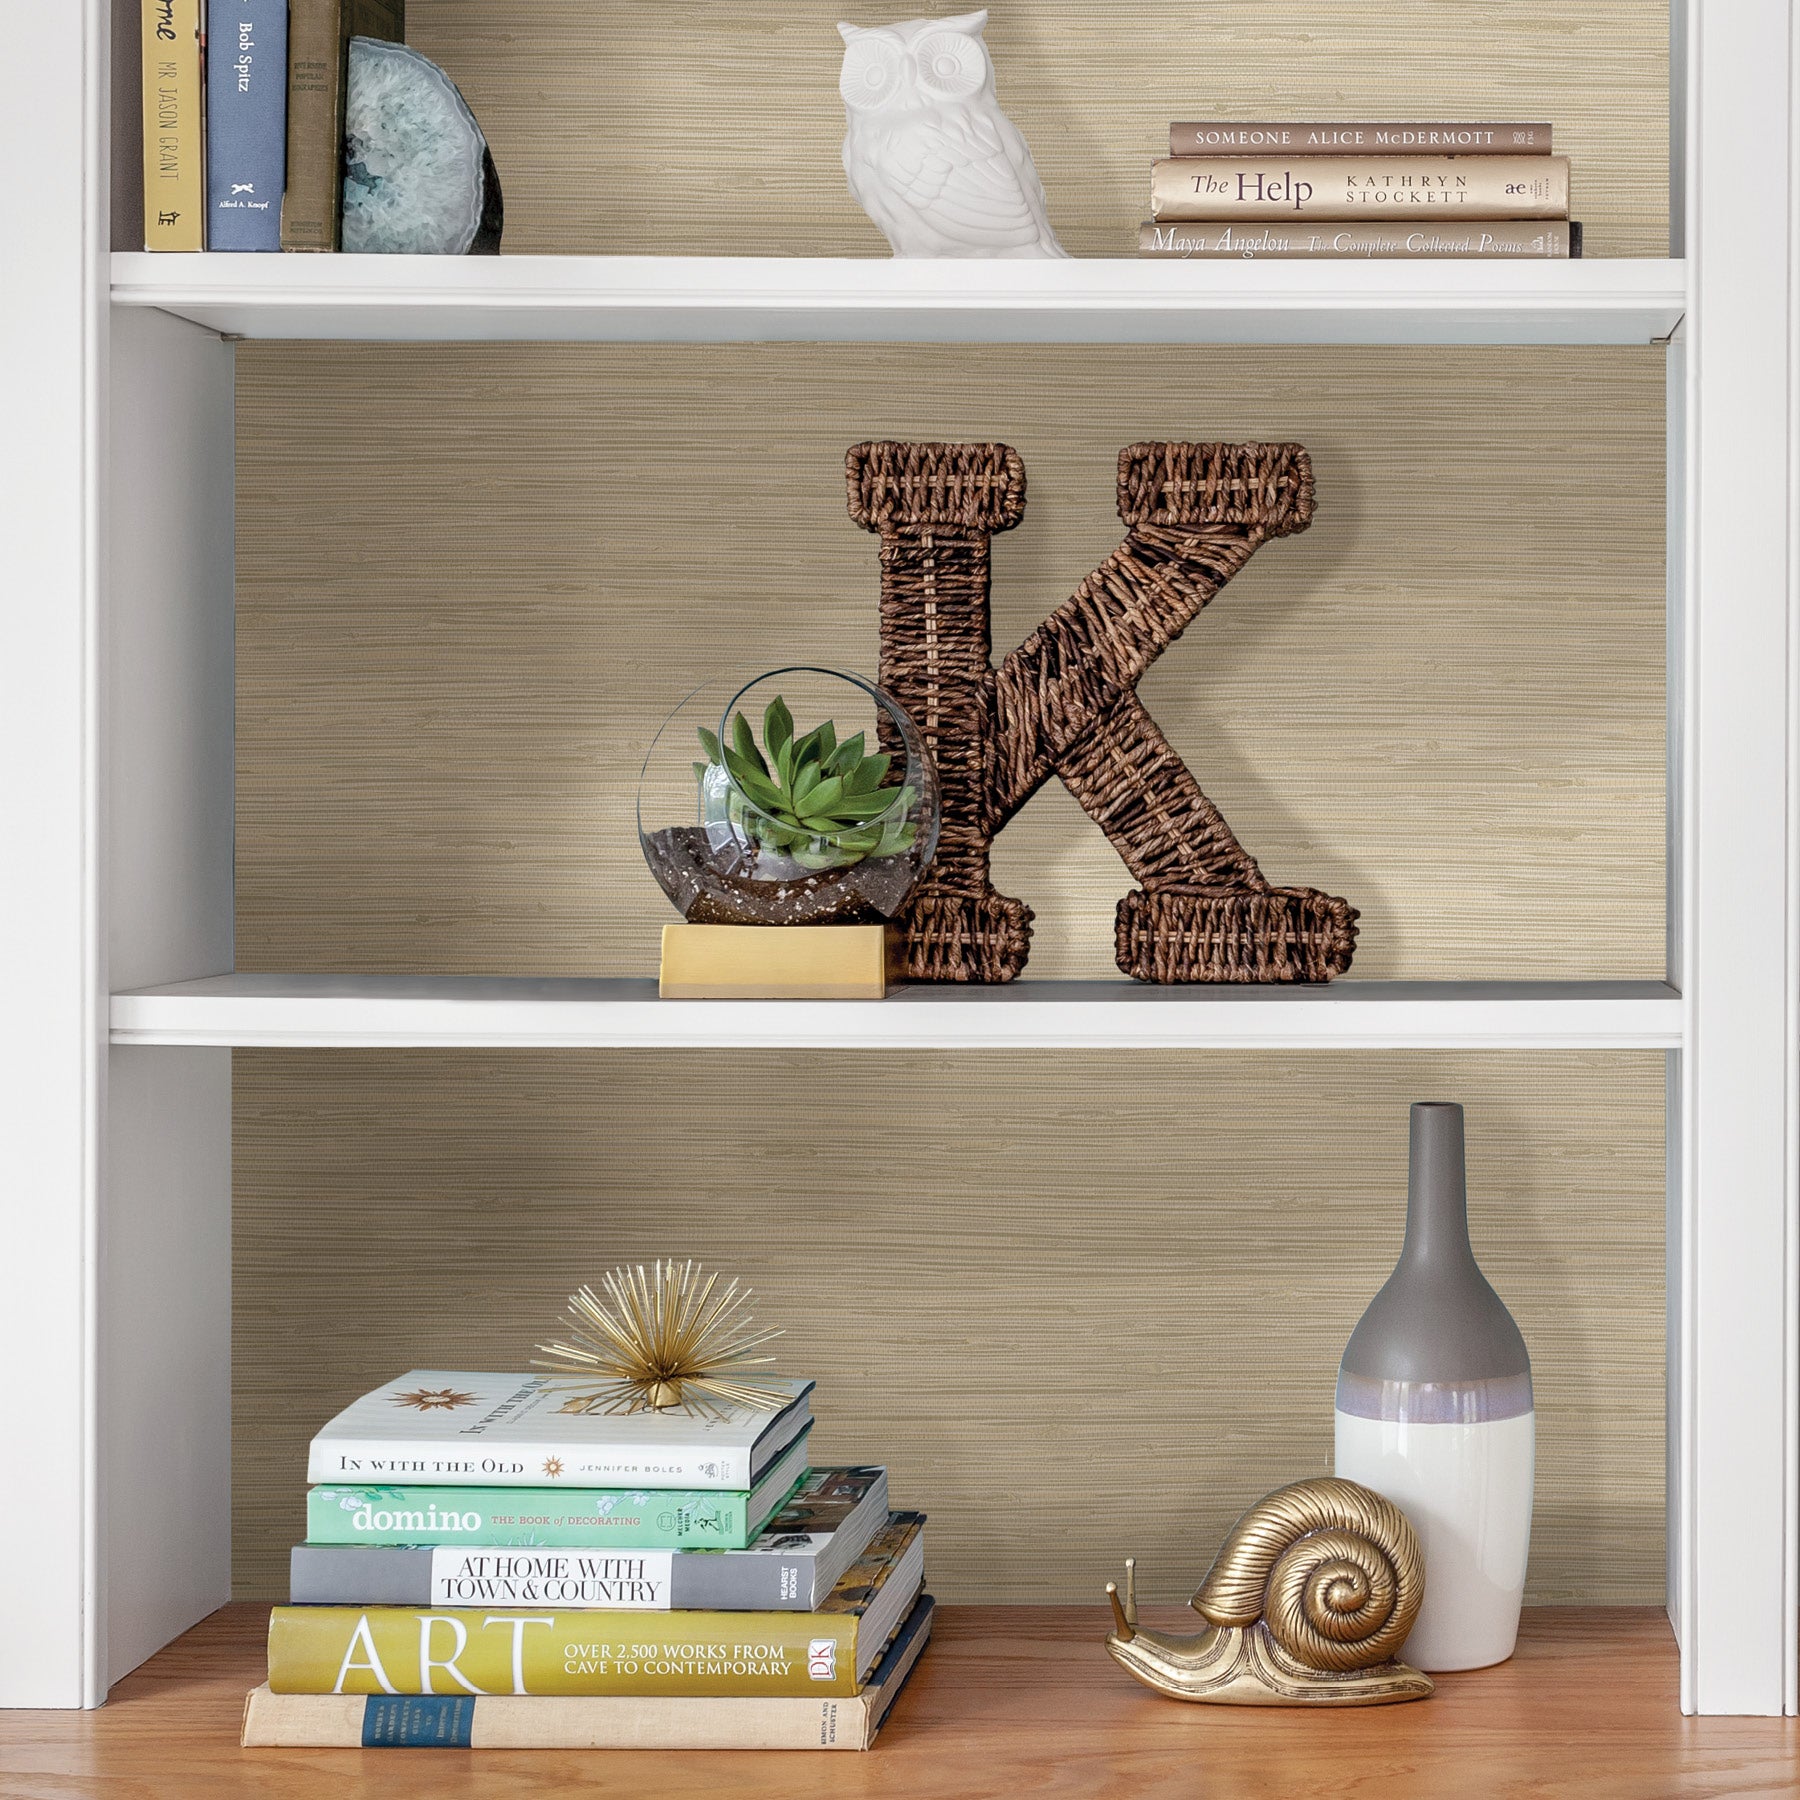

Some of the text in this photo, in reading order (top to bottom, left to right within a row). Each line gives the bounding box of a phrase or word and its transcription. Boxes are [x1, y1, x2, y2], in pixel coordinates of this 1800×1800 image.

[233, 22, 255, 92] Bob Spitz
[158, 61, 180, 181] MR JASON GRANT
[1195, 131, 1495, 145] SOMEONE ALICE McDERMOTT
[1190, 171, 1313, 211] The Help
[1347, 175, 1467, 187] KATHRYN
[1346, 191, 1468, 203] STOCKETT
[1151, 227, 1206, 258] Maya
[1215, 227, 1290, 258] Angelou
[1333, 233, 1397, 257] Complete
[1406, 233, 1471, 253] Collected
[1479, 233, 1524, 253] Poems
[579, 1465, 684, 1474] JENNIFER BOLES
[352, 1504, 482, 1532] domino
[491, 1515, 641, 1527] THE BOOK of DECORATING
[456, 1556, 647, 1580] AT HOME WITH
[441, 1578, 662, 1602] TOWN & COUNTRY
[780, 1566, 789, 1601] HEARST
[789, 1567, 798, 1599] BOOKS
[331, 1613, 555, 1695] ART
[563, 1644, 785, 1660] OVER 2,500 WORKS FROM
[811, 1645, 831, 1677] DK
[563, 1661, 793, 1676] CAVE TO CONTEMPORARY
[820, 1721, 828, 1745] SIMON
[829, 1703, 837, 1743] SCHUSTER
